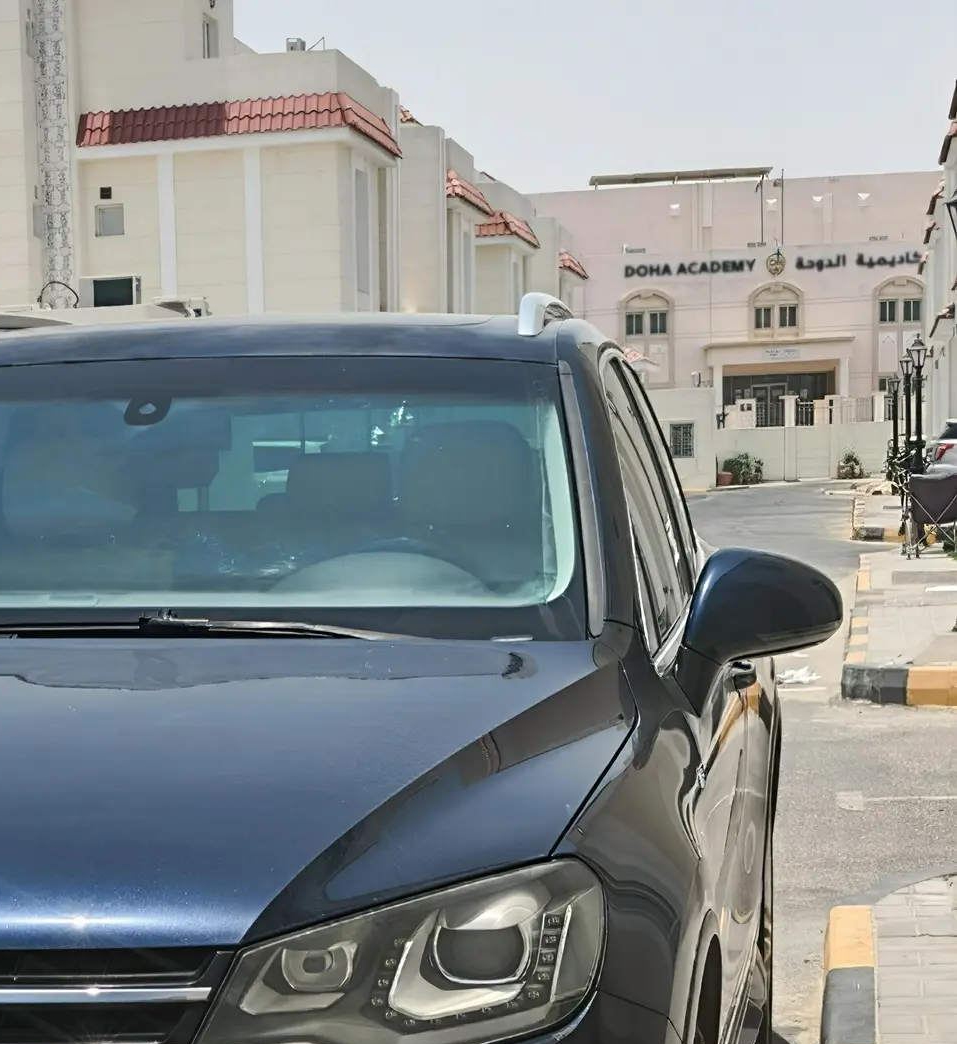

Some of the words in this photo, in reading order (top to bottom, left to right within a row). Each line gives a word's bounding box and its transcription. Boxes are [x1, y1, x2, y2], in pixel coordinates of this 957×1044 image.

[624, 263, 672, 278] DOHA
[677, 258, 756, 275] ACADEMY
[795, 253, 846, 272] الدوحة
[856, 250, 921, 269] كاديمية
